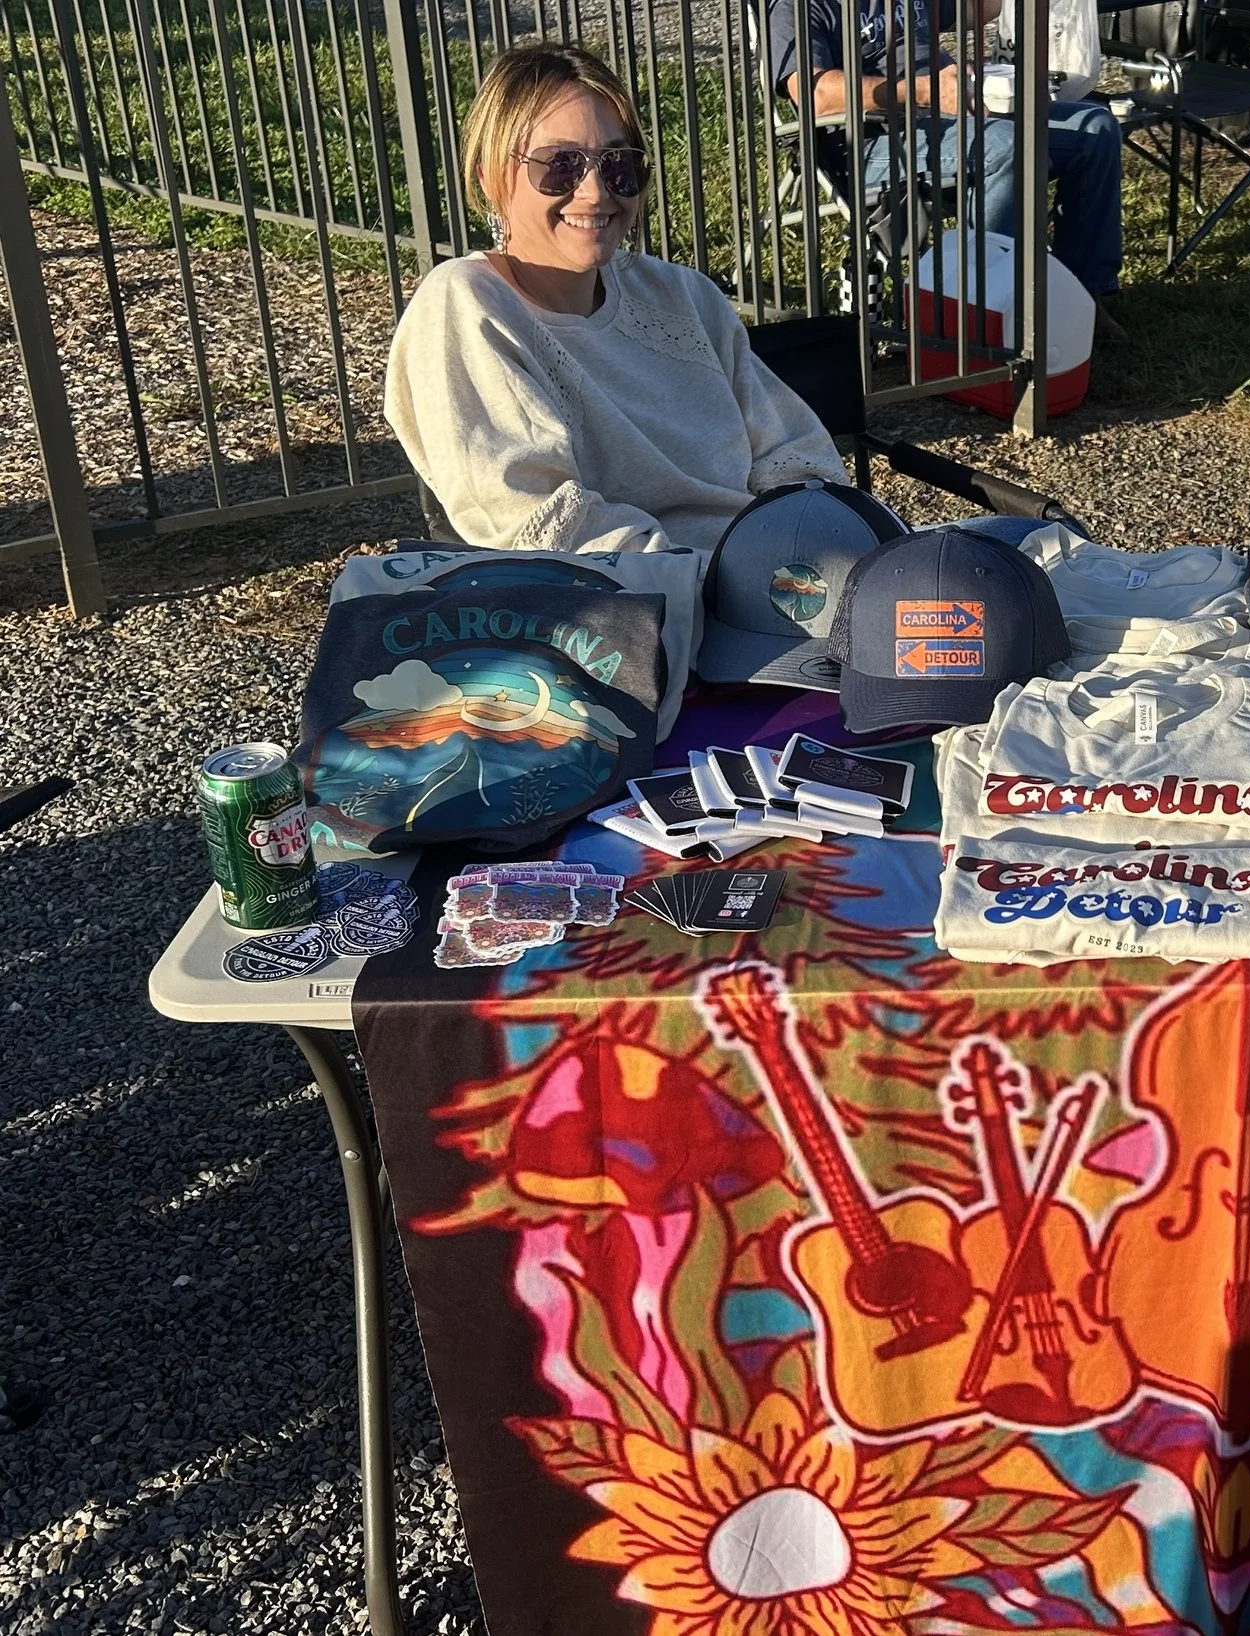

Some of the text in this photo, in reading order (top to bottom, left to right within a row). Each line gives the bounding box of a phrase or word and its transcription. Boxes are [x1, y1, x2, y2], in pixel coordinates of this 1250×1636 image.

[902, 613, 968, 626] CAROLINA
[382, 606, 624, 685] CAROLINA
[925, 650, 979, 664] DETOUR
[248, 811, 307, 849] CANAD
[276, 831, 308, 858] DRY
[266, 879, 311, 904] GINGER
[984, 882, 1245, 927] Detour
[1088, 935, 1144, 953] EST 2023
[240, 945, 309, 968] CAROLINA DETOUR
[253, 970, 288, 979] DETOUR
[320, 985, 353, 996] LIFE
